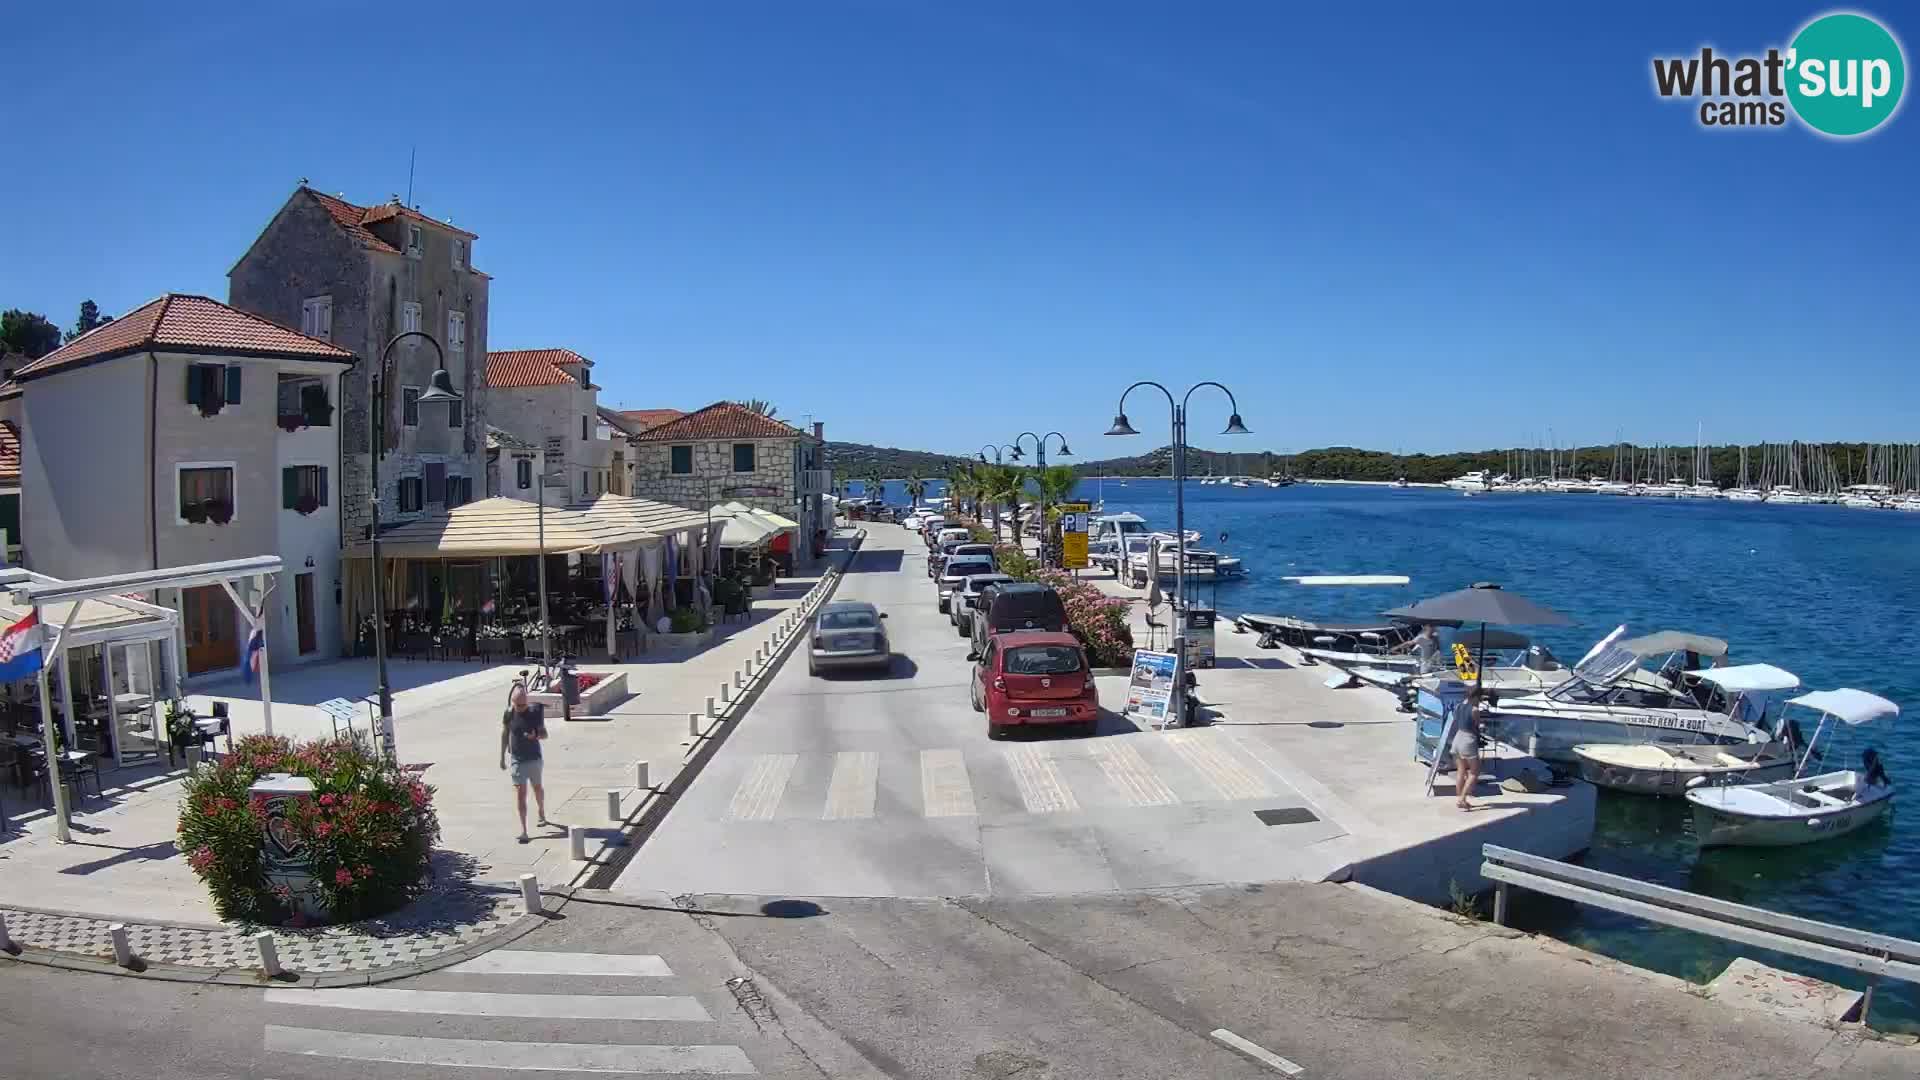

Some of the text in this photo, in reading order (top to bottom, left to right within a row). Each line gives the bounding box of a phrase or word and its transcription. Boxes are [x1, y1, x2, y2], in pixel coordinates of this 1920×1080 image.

[1065, 514, 1075, 530] P
[1658, 715, 1678, 728] RENT
[1679, 718, 1685, 728] A
[1686, 719, 1707, 731] BOAT
